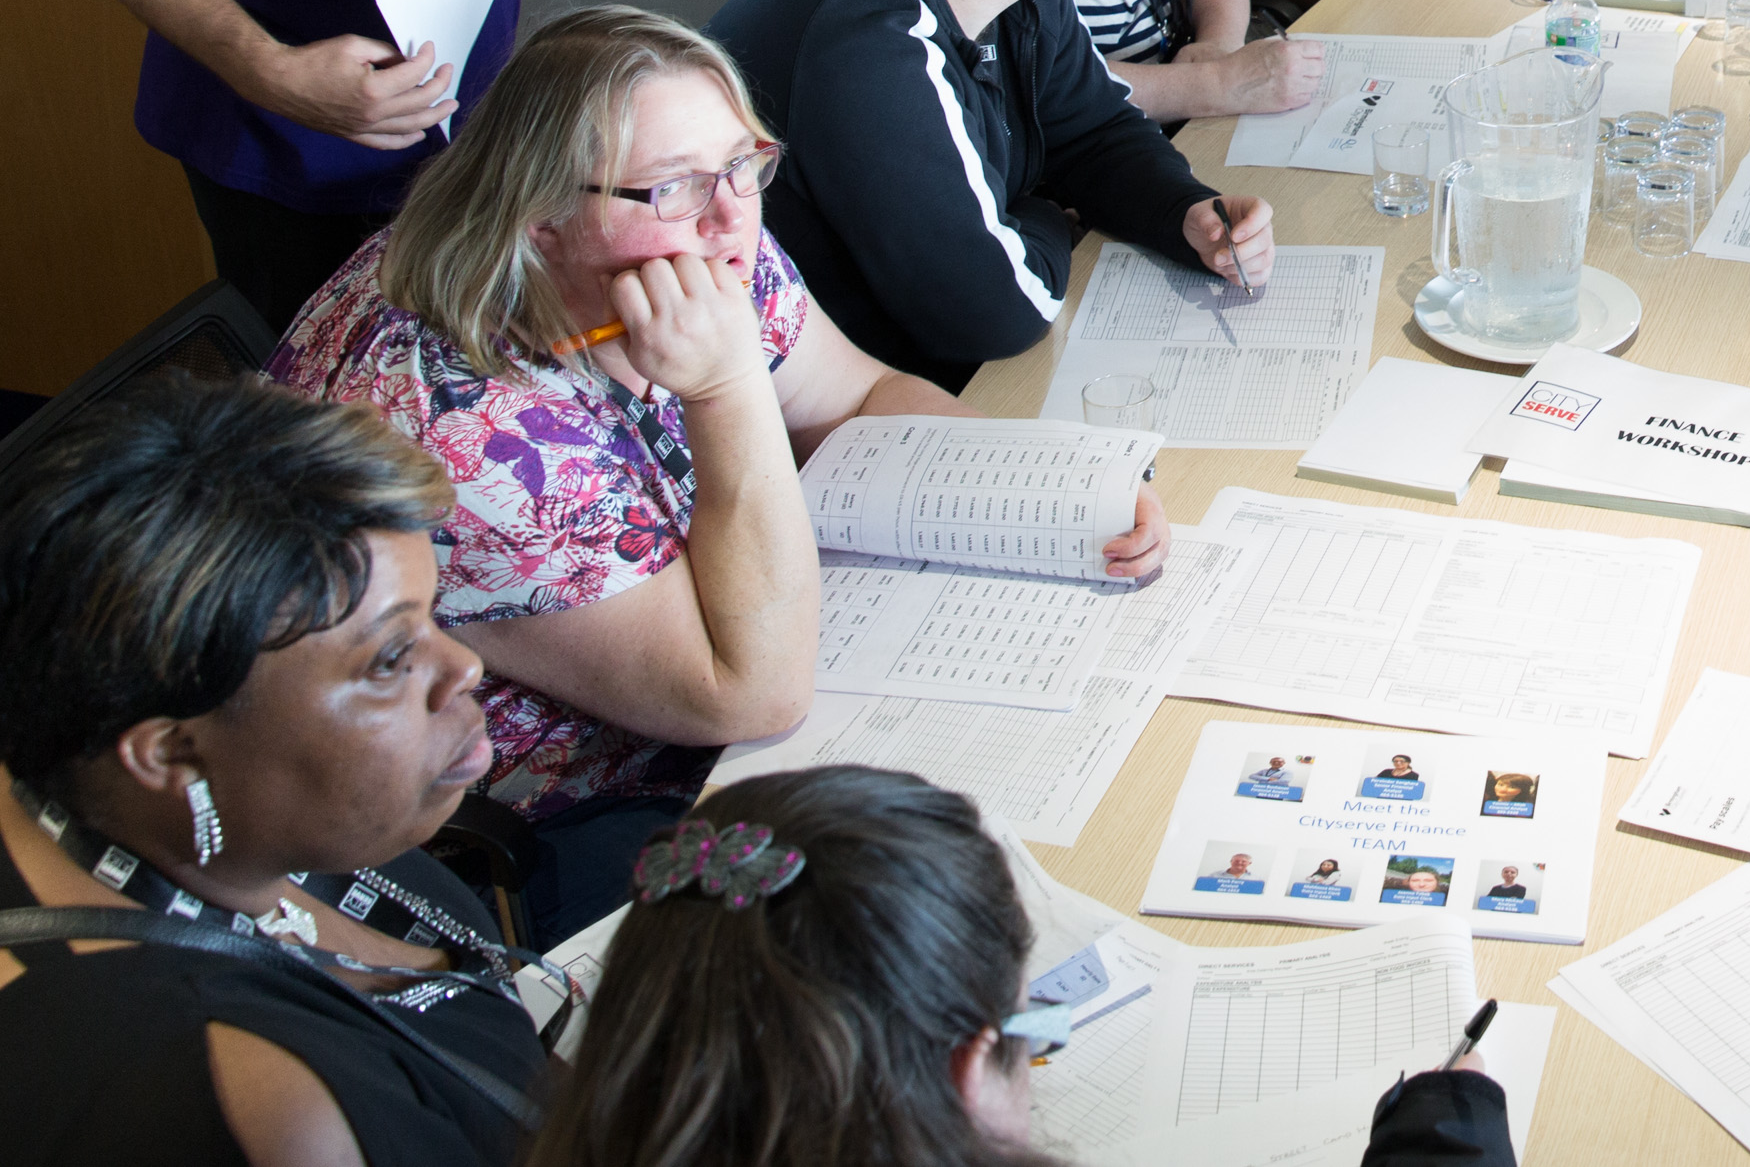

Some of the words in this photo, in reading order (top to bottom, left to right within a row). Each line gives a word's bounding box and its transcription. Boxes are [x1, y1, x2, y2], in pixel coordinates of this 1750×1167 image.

[1531, 389, 1592, 412] CITY
[1522, 401, 1581, 423] SERVE
[902, 427, 915, 441] Grade
[1645, 415, 1745, 443] FINANCE
[1126, 440, 1138, 453] Grade
[1343, 800, 1392, 812] Meet
[1399, 803, 1430, 816] the
[1710, 813, 1724, 830] Pay
[1718, 796, 1735, 816] scales
[1299, 814, 1387, 833] Cityserve
[1392, 820, 1467, 837] Finance
[1350, 837, 1408, 852] TEAM
